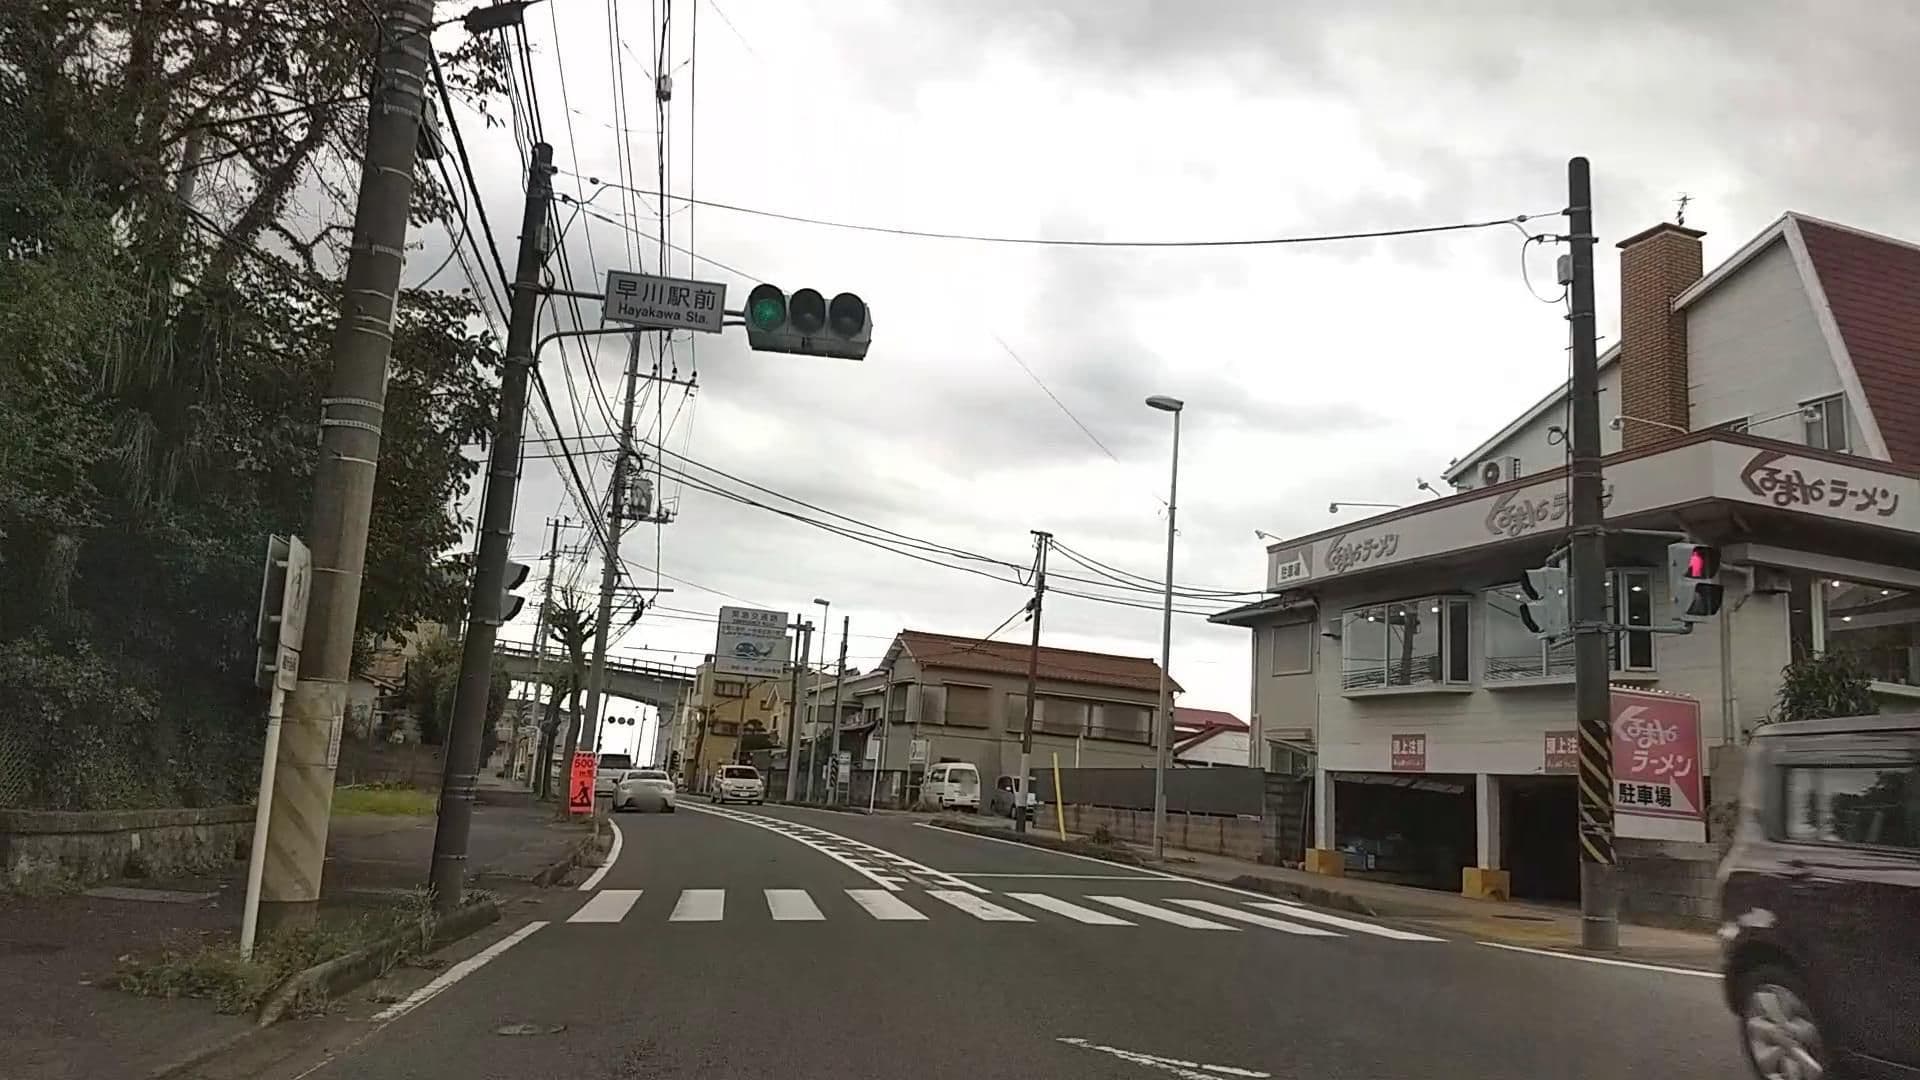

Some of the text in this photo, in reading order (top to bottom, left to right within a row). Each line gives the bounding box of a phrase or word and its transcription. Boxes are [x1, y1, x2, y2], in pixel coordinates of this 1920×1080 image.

[616, 279, 716, 310] 早川駅前
[618, 303, 708, 325] Hayakawa Sta.
[1631, 750, 1693, 777] ラーメン
[1618, 783, 1673, 808] 駐車場
